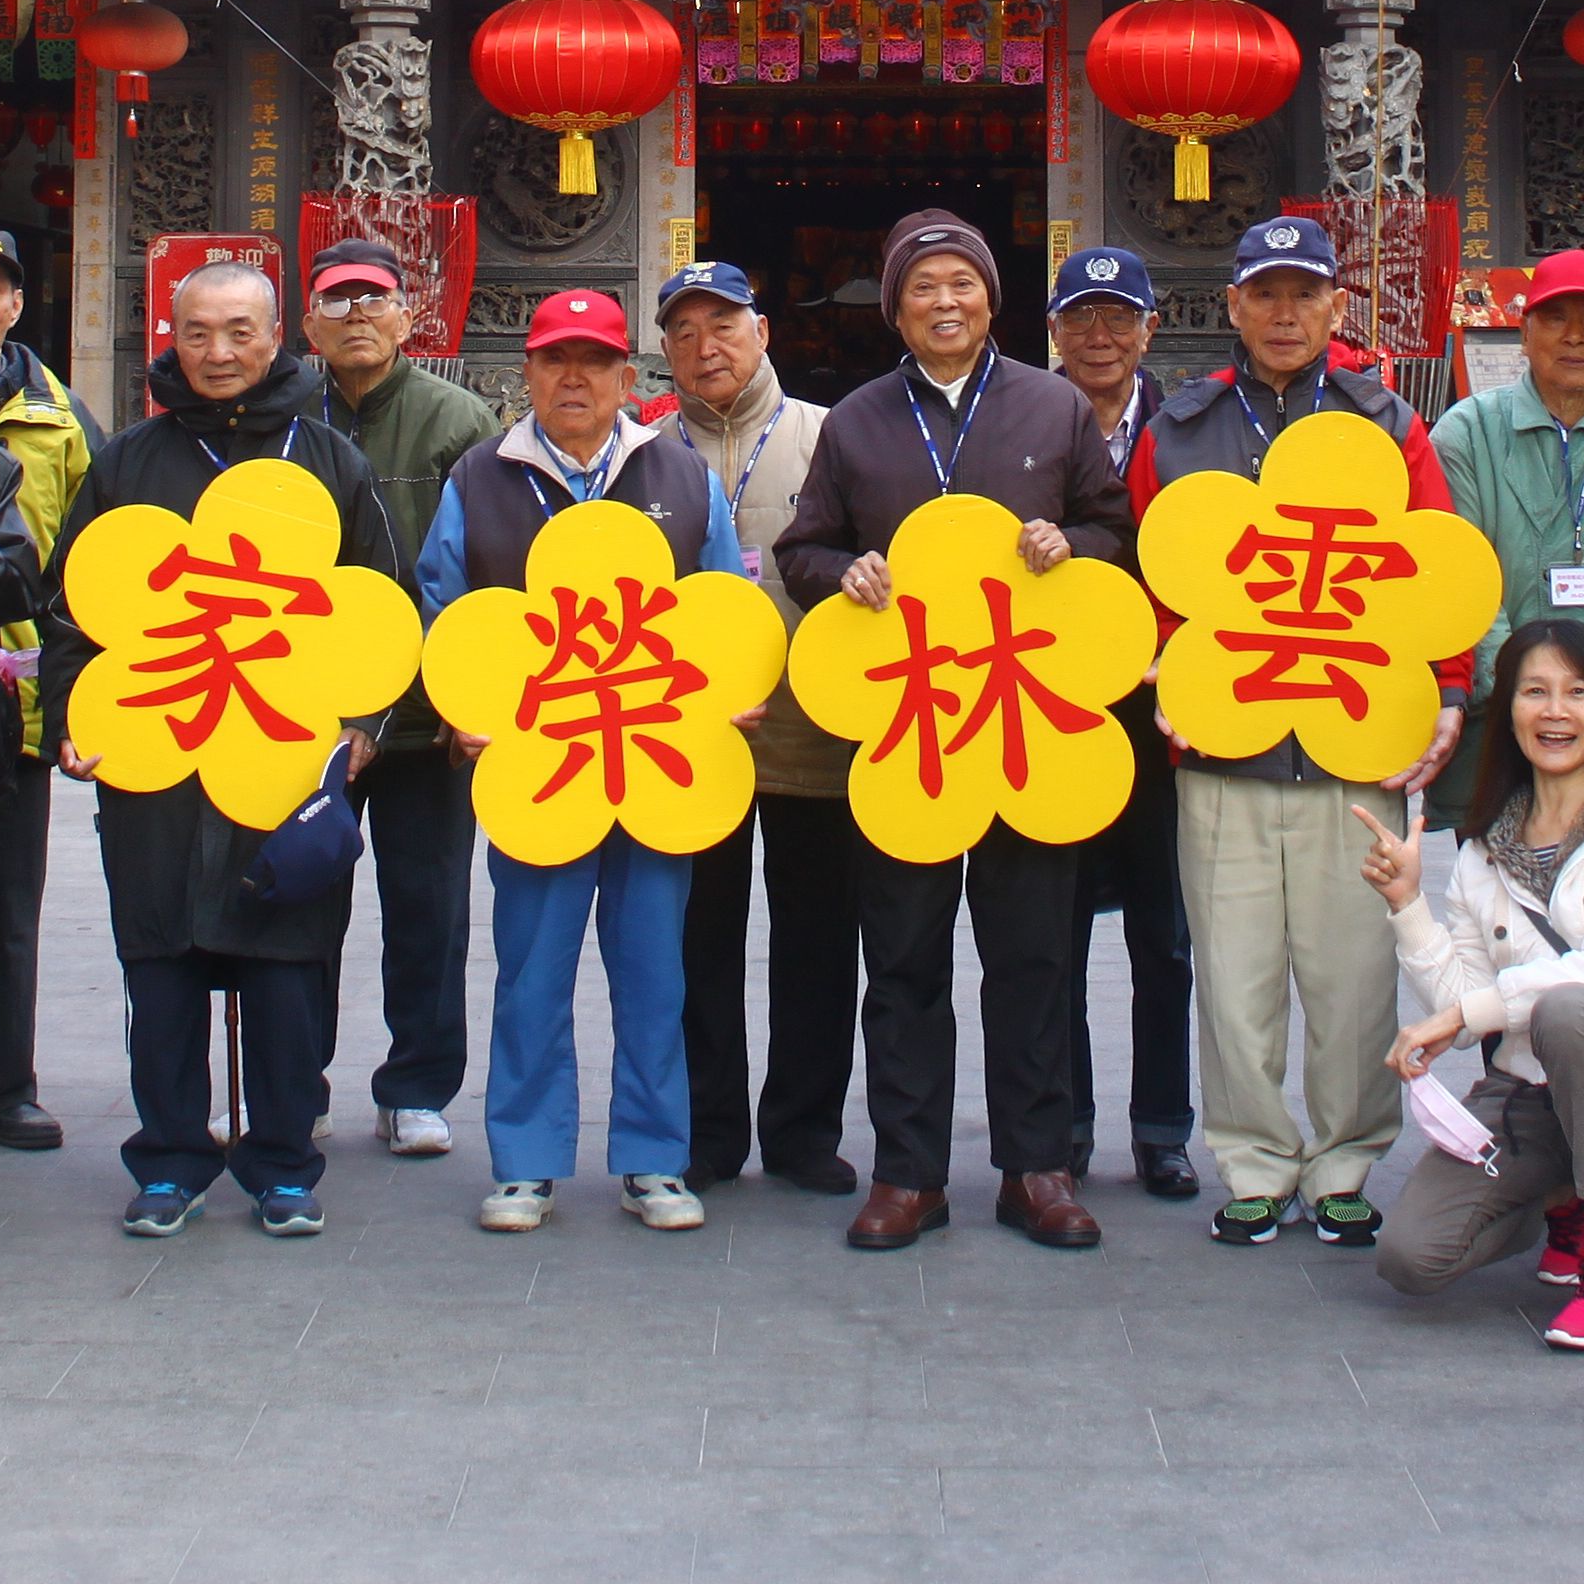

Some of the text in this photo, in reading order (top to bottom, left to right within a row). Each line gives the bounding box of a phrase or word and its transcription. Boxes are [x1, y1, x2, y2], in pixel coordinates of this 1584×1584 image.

[117, 533, 333, 752] 家
[515, 576, 709, 806] 榮
[864, 577, 1106, 799] 林
[1215, 503, 1419, 721] 雲
